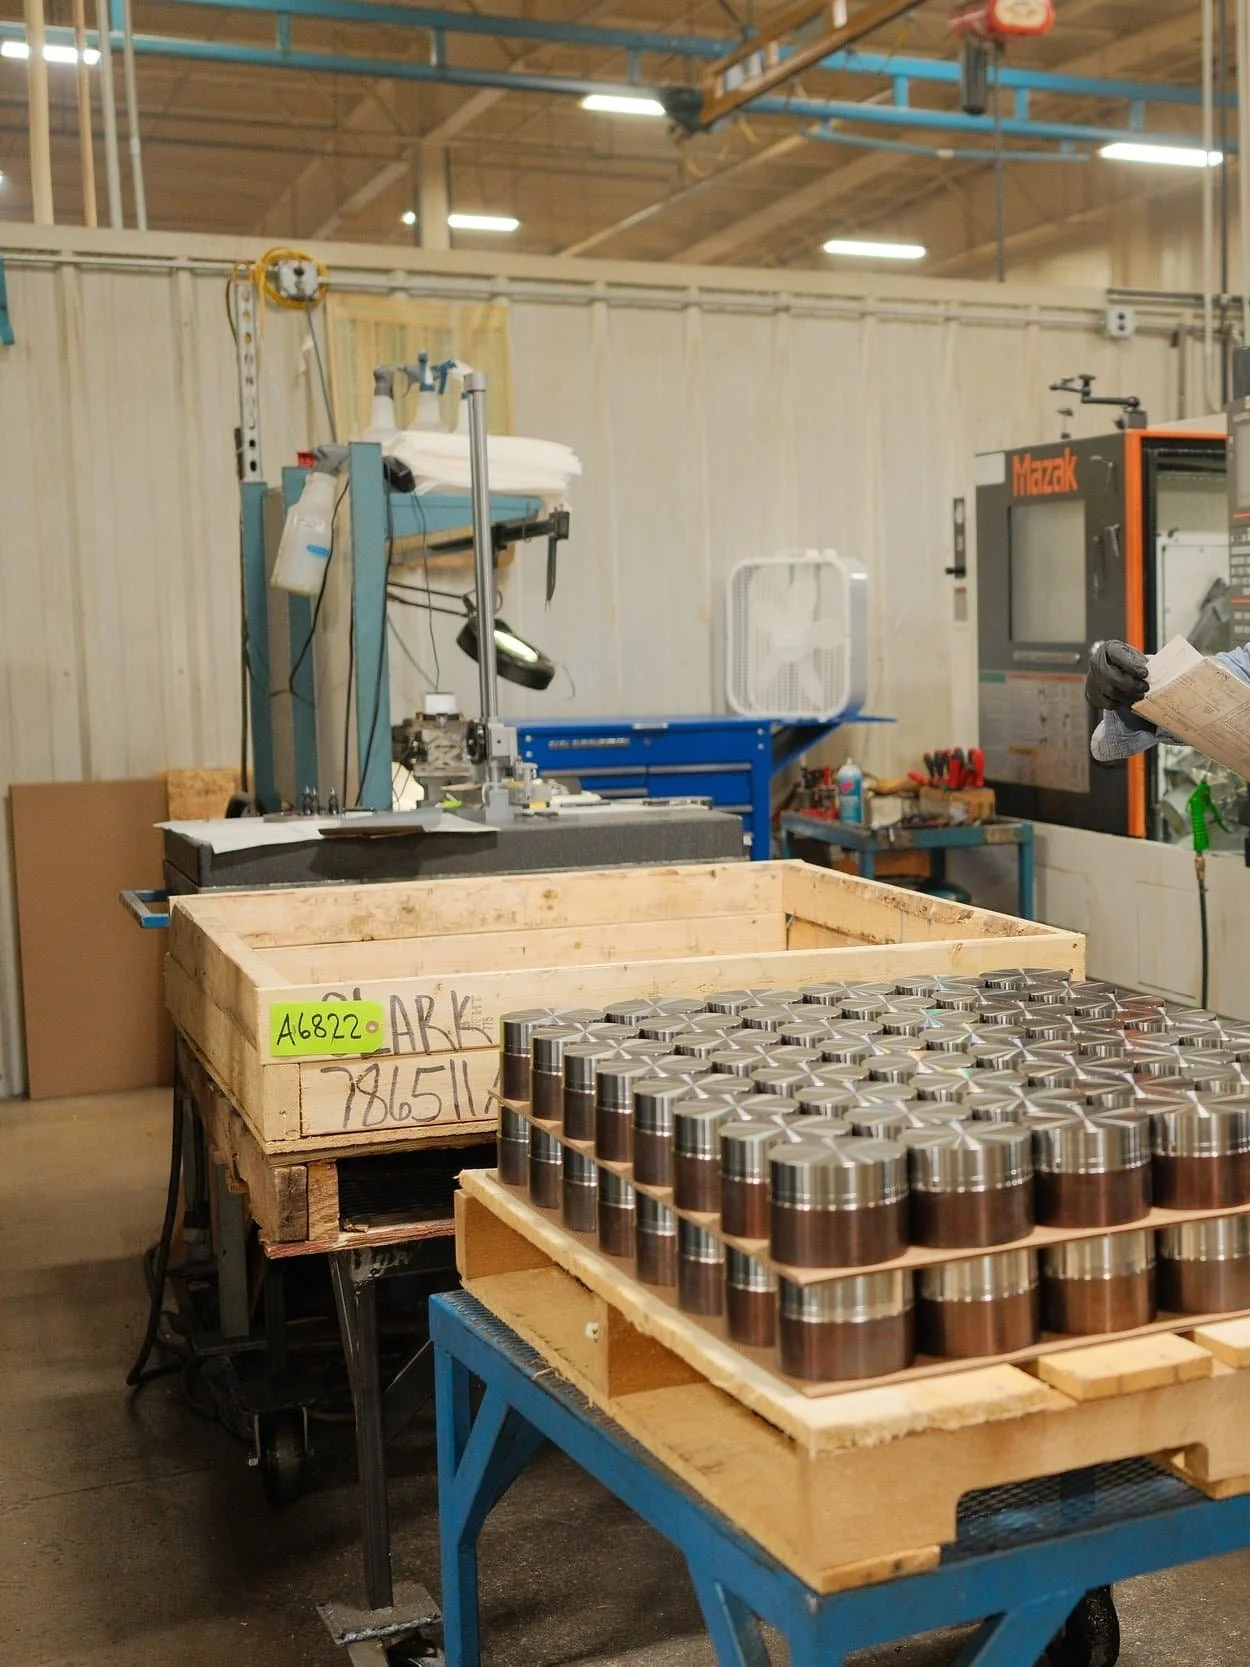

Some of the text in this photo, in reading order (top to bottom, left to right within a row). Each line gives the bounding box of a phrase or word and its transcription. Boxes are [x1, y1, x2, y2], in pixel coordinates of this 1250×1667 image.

[1012, 448, 1079, 497] Mazak
[276, 1012, 362, 1046] A6822
[321, 986, 493, 1060] ARK
